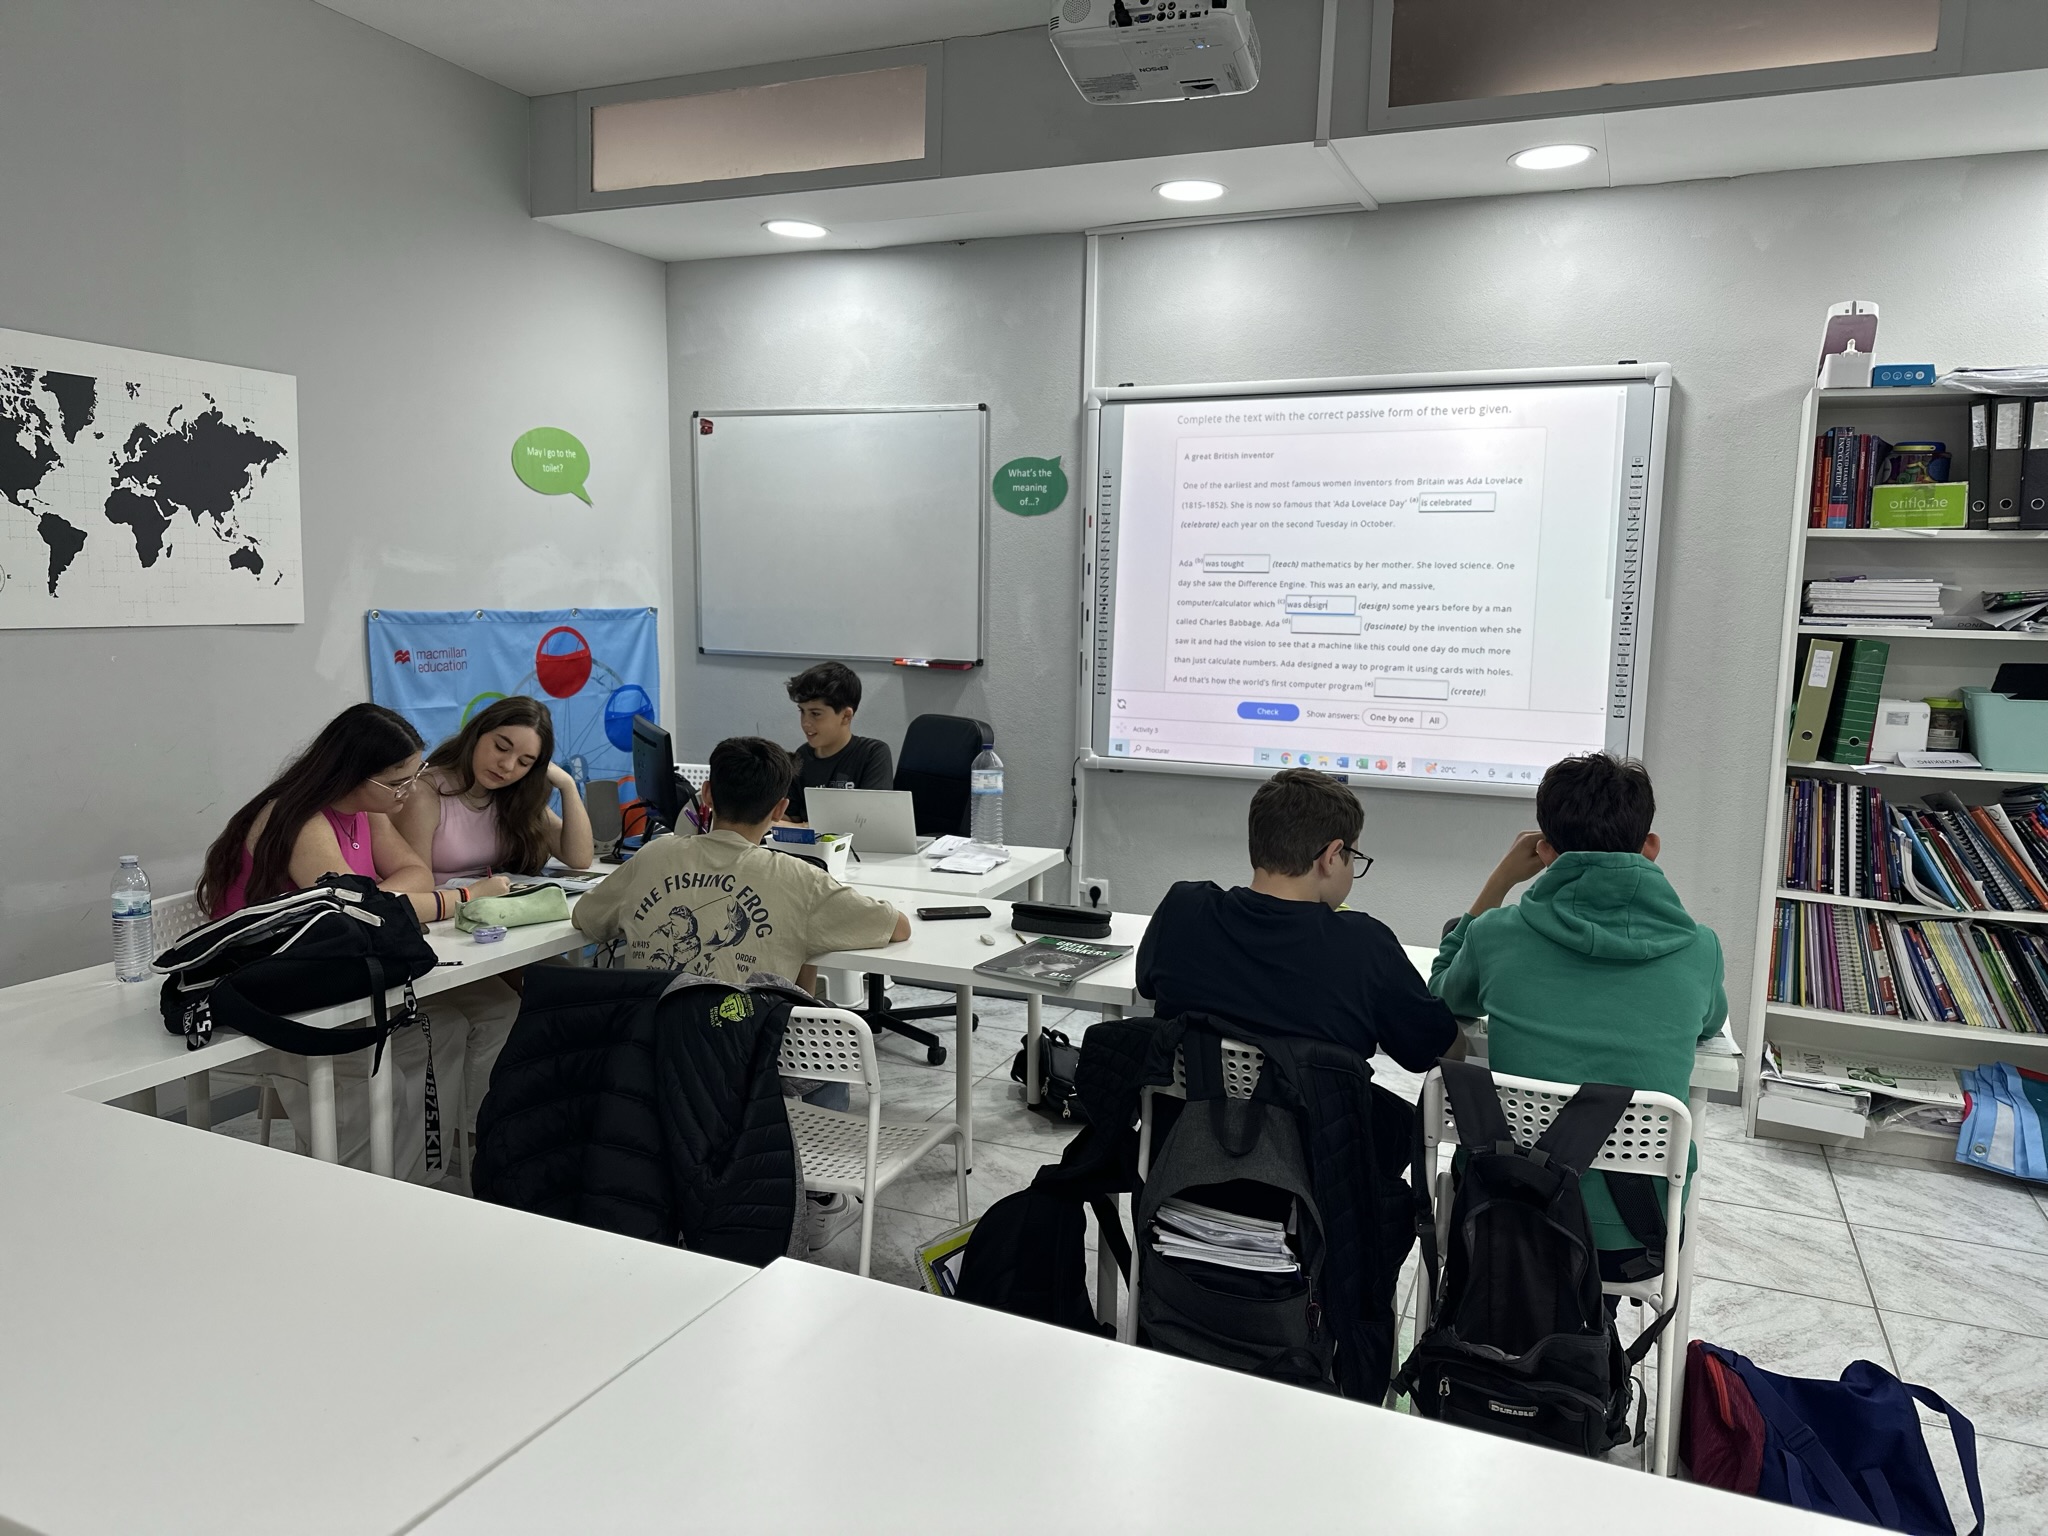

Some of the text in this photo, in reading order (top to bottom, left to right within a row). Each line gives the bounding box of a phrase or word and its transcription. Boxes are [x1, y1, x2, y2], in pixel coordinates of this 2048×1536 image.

[1176, 413, 1222, 426] Complete
[1224, 413, 1240, 423] the
[1243, 413, 1262, 422] text
[1264, 411, 1286, 421] with
[1288, 411, 1305, 421] the
[1307, 410, 1344, 420] correct
[1346, 408, 1385, 420] passive
[1387, 407, 1413, 417] form
[1430, 406, 1448, 416] the
[1450, 405, 1476, 415] verb
[1478, 405, 1512, 416] given.
[526, 446, 542, 458] May
[547, 450, 556, 459] go
[557, 449, 564, 458] to
[565, 449, 576, 458] the
[1190, 453, 1212, 462] great
[1213, 452, 1239, 460] British
[542, 463, 564, 472] toilet?
[1835, 437, 1845, 488] ENCYCLOPEDIC
[1008, 468, 1052, 477] What's the
[1012, 483, 1047, 493] meaning
[1182, 481, 1198, 489] One
[1291, 479, 1321, 488] famous
[1394, 478, 1414, 486] from
[1416, 477, 1445, 486] Britain
[1465, 476, 1483, 485] Ada
[1484, 476, 1523, 485] Lovelace
[1230, 500, 1245, 509] She
[1283, 500, 1312, 508] famous
[1314, 500, 1331, 508] that
[1351, 499, 1387, 508] Lovelace
[1428, 498, 1472, 506] celebrated
[1180, 520, 1220, 528] (celebrate)
[1240, 521, 1258, 530] year
[1285, 520, 1314, 528] second
[1315, 519, 1348, 529] Tuesday
[1359, 519, 1395, 528] October.
[1178, 559, 1193, 567] Ada
[1220, 560, 1244, 570] tought
[1271, 560, 1299, 568] (teach)
[1364, 560, 1380, 568] her
[1416, 560, 1432, 569] She
[1434, 561, 1458, 569] loved
[1459, 561, 1494, 570] science.
[1496, 561, 1515, 570] One
[1237, 579, 1278, 588] Difference
[1279, 580, 1307, 590] Engine.
[1309, 580, 1326, 588] This
[1357, 582, 1380, 591] early,
[1381, 581, 1398, 590] and
[1176, 599, 1252, 607] computer/calculator
[1357, 602, 1390, 612] (design)
[1415, 604, 1440, 613] years
[1441, 603, 1470, 612] before
[1198, 617, 1227, 626] Charles
[1228, 618, 1263, 628] Babbage.
[1264, 619, 1280, 627] Ada
[1363, 622, 1407, 631] (fascinate)
[1479, 625, 1504, 633] when
[1505, 626, 1522, 634] she
[1213, 638, 1228, 646] had
[1317, 642, 1352, 650] machine
[1353, 642, 1368, 650] like
[1369, 643, 1385, 651] this
[1386, 644, 1410, 652] could
[1430, 644, 1446, 655] day
[1460, 646, 1485, 654] much
[416, 647, 467, 659] macmillan
[418, 660, 468, 673] education
[1191, 656, 1206, 665] just
[1207, 657, 1241, 665] calculate
[1242, 659, 1278, 667] numbers.
[1279, 659, 1295, 668] Ada
[1296, 660, 1333, 670] designed
[1341, 663, 1358, 672] way
[1369, 664, 1405, 674] program
[1415, 665, 1438, 675] using
[1439, 666, 1463, 674] cards
[1465, 667, 1485, 675] with
[1486, 667, 1513, 676] holes.
[1172, 674, 1363, 692] And that's how world's first computer program
[1256, 707, 1279, 715] Check
[1306, 709, 1360, 720] Show answers:
[1369, 712, 1386, 722] One
[1428, 716, 1440, 724] All
[855, 814, 867, 828] hp
[634, 872, 773, 938] THE FISHING FROG
[632, 940, 650, 949] ALWAYS
[1056, 940, 1089, 949] GREAT
[633, 951, 645, 959] OPEN
[1056, 946, 1110, 956] THINKERS
[735, 952, 757, 964] ORDER
[737, 964, 749, 972] NOW
[1491, 1404, 1534, 1417] DURABLE
